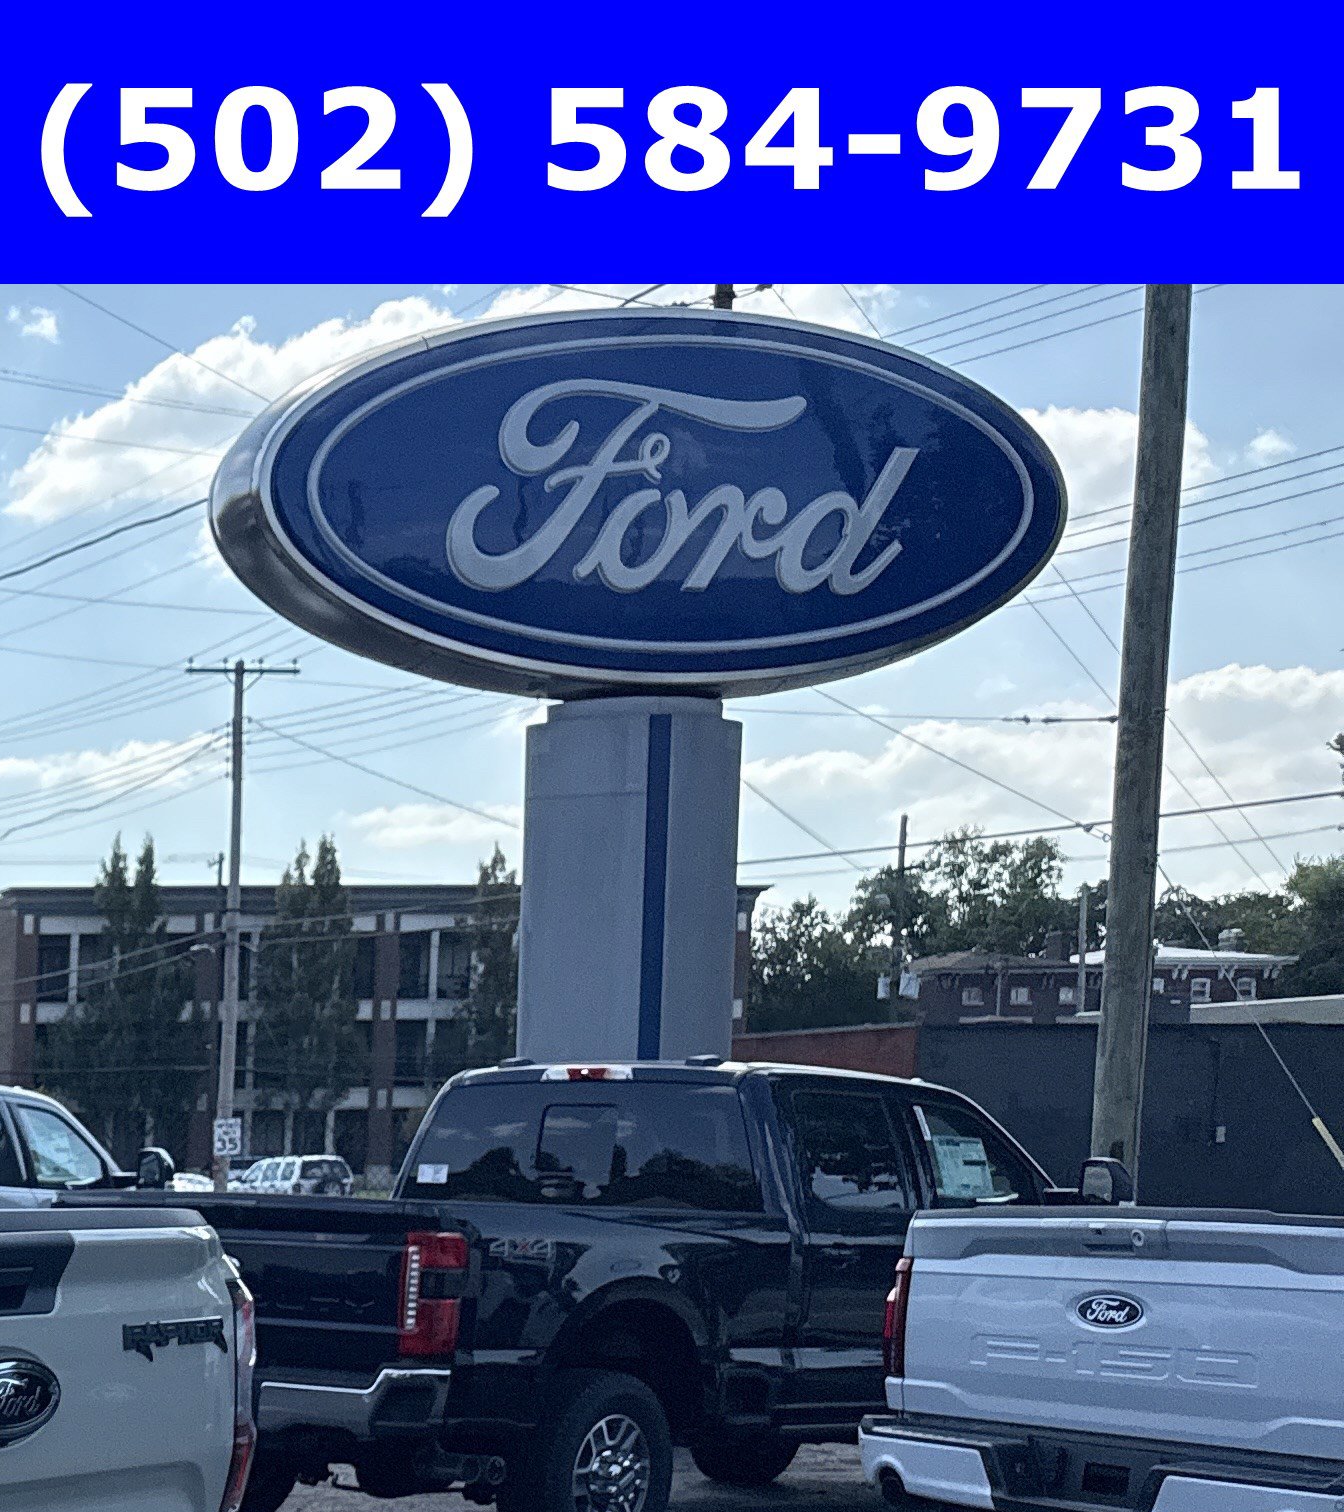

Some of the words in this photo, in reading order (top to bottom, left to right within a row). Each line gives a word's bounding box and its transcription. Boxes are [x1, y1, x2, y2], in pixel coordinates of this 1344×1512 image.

[445, 377, 922, 597] Ford
[216, 1137, 238, 1153] 35
[1086, 1298, 1128, 1323] Ford
[122, 1315, 229, 1362] RAPTOR
